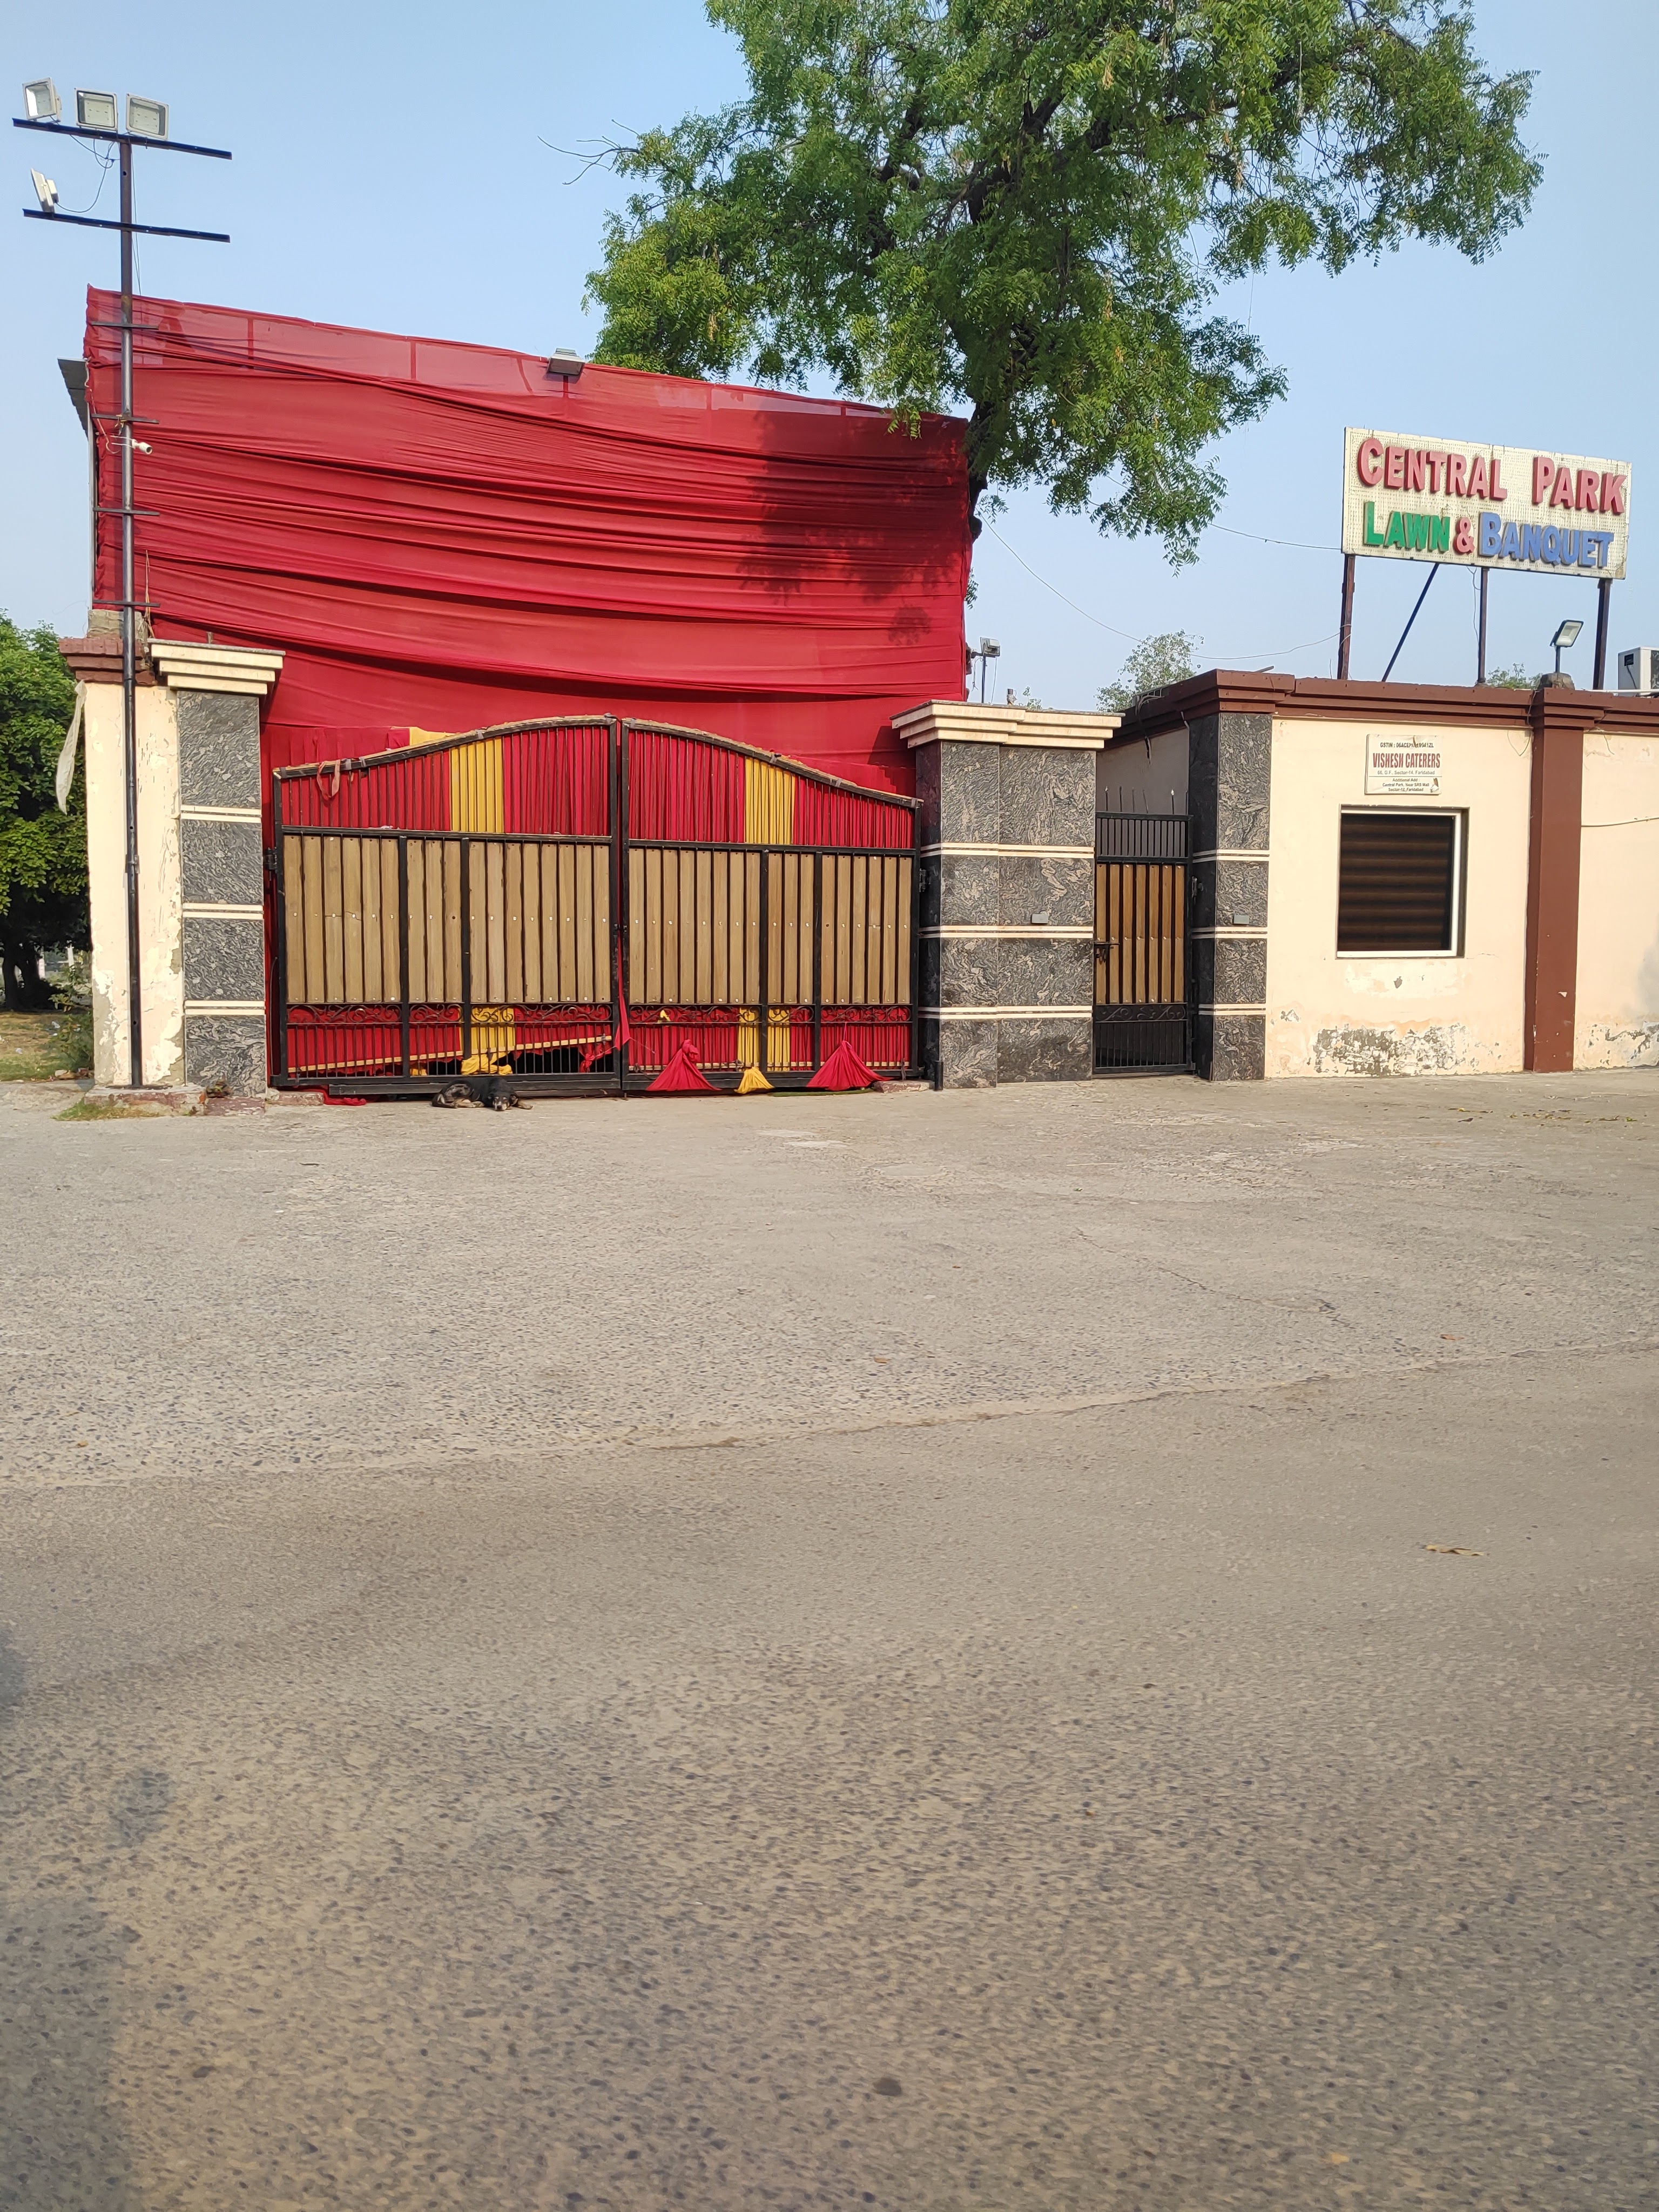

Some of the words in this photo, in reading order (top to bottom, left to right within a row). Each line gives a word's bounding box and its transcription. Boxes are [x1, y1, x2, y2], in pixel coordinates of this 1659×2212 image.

[1357, 437, 1507, 500] CENTRAL
[1532, 456, 1627, 515] PARK
[1364, 501, 1451, 553] LAWN
[1453, 517, 1475, 555] &
[1479, 512, 1614, 568] BANQUET
[1373, 753, 1404, 768] VISHESH
[1405, 753, 1440, 768] CATERERS
